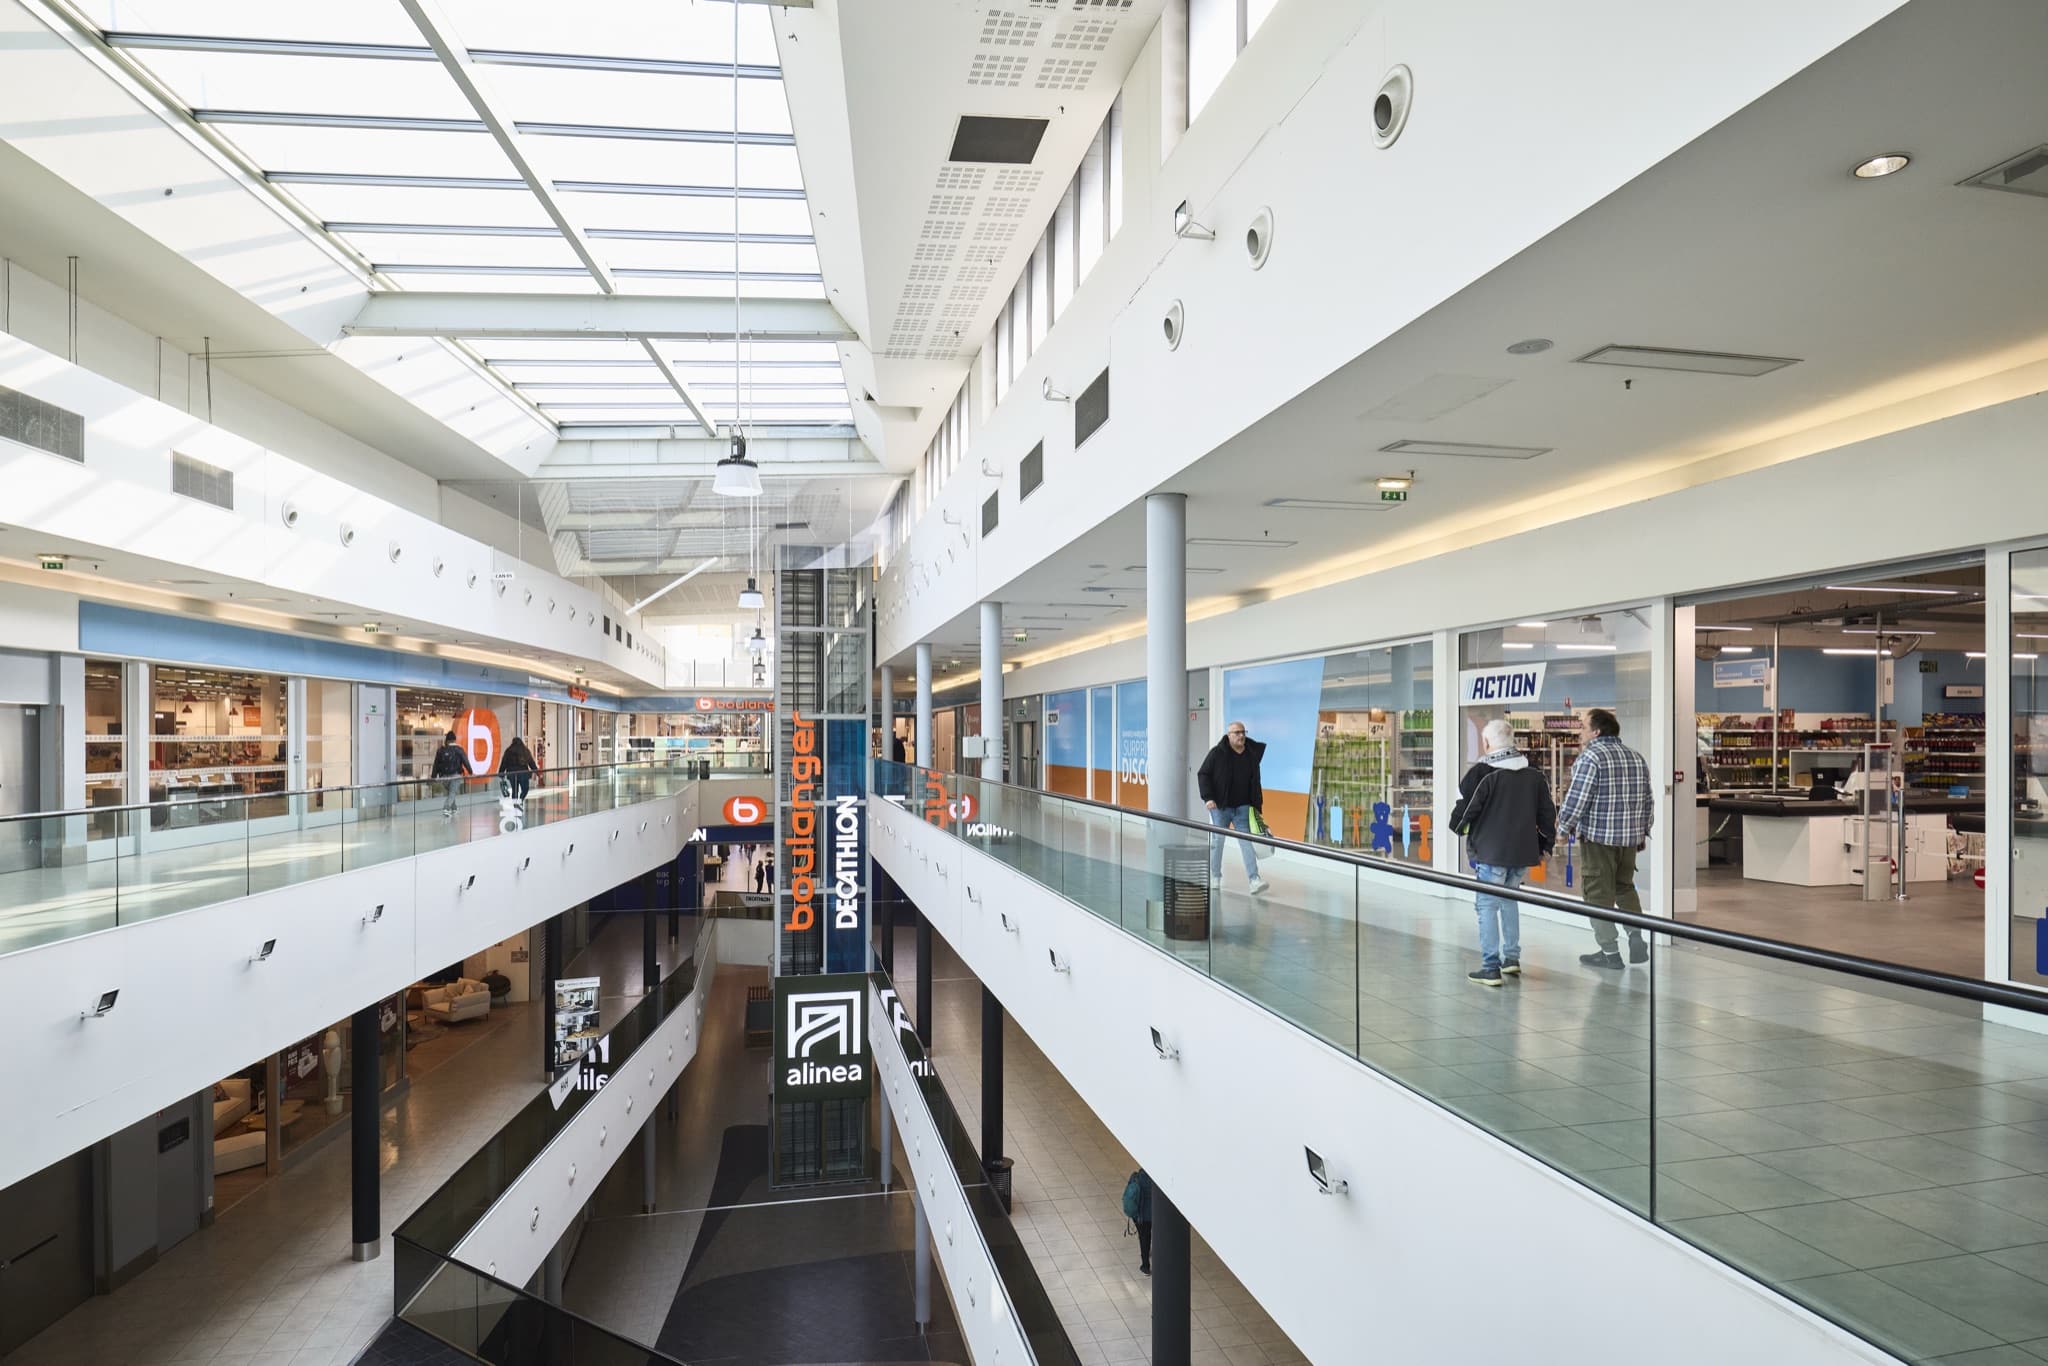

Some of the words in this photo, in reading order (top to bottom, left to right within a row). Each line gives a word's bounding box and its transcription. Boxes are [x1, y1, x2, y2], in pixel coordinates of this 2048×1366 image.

[1472, 672, 1537, 700] ACTION
[467, 709, 494, 776] b
[1122, 740, 1149, 757] SURPRI
[733, 798, 759, 824] b
[785, 711, 821, 931] boulanger
[835, 795, 858, 930] DECATHLON
[786, 1061, 862, 1087] alinea
